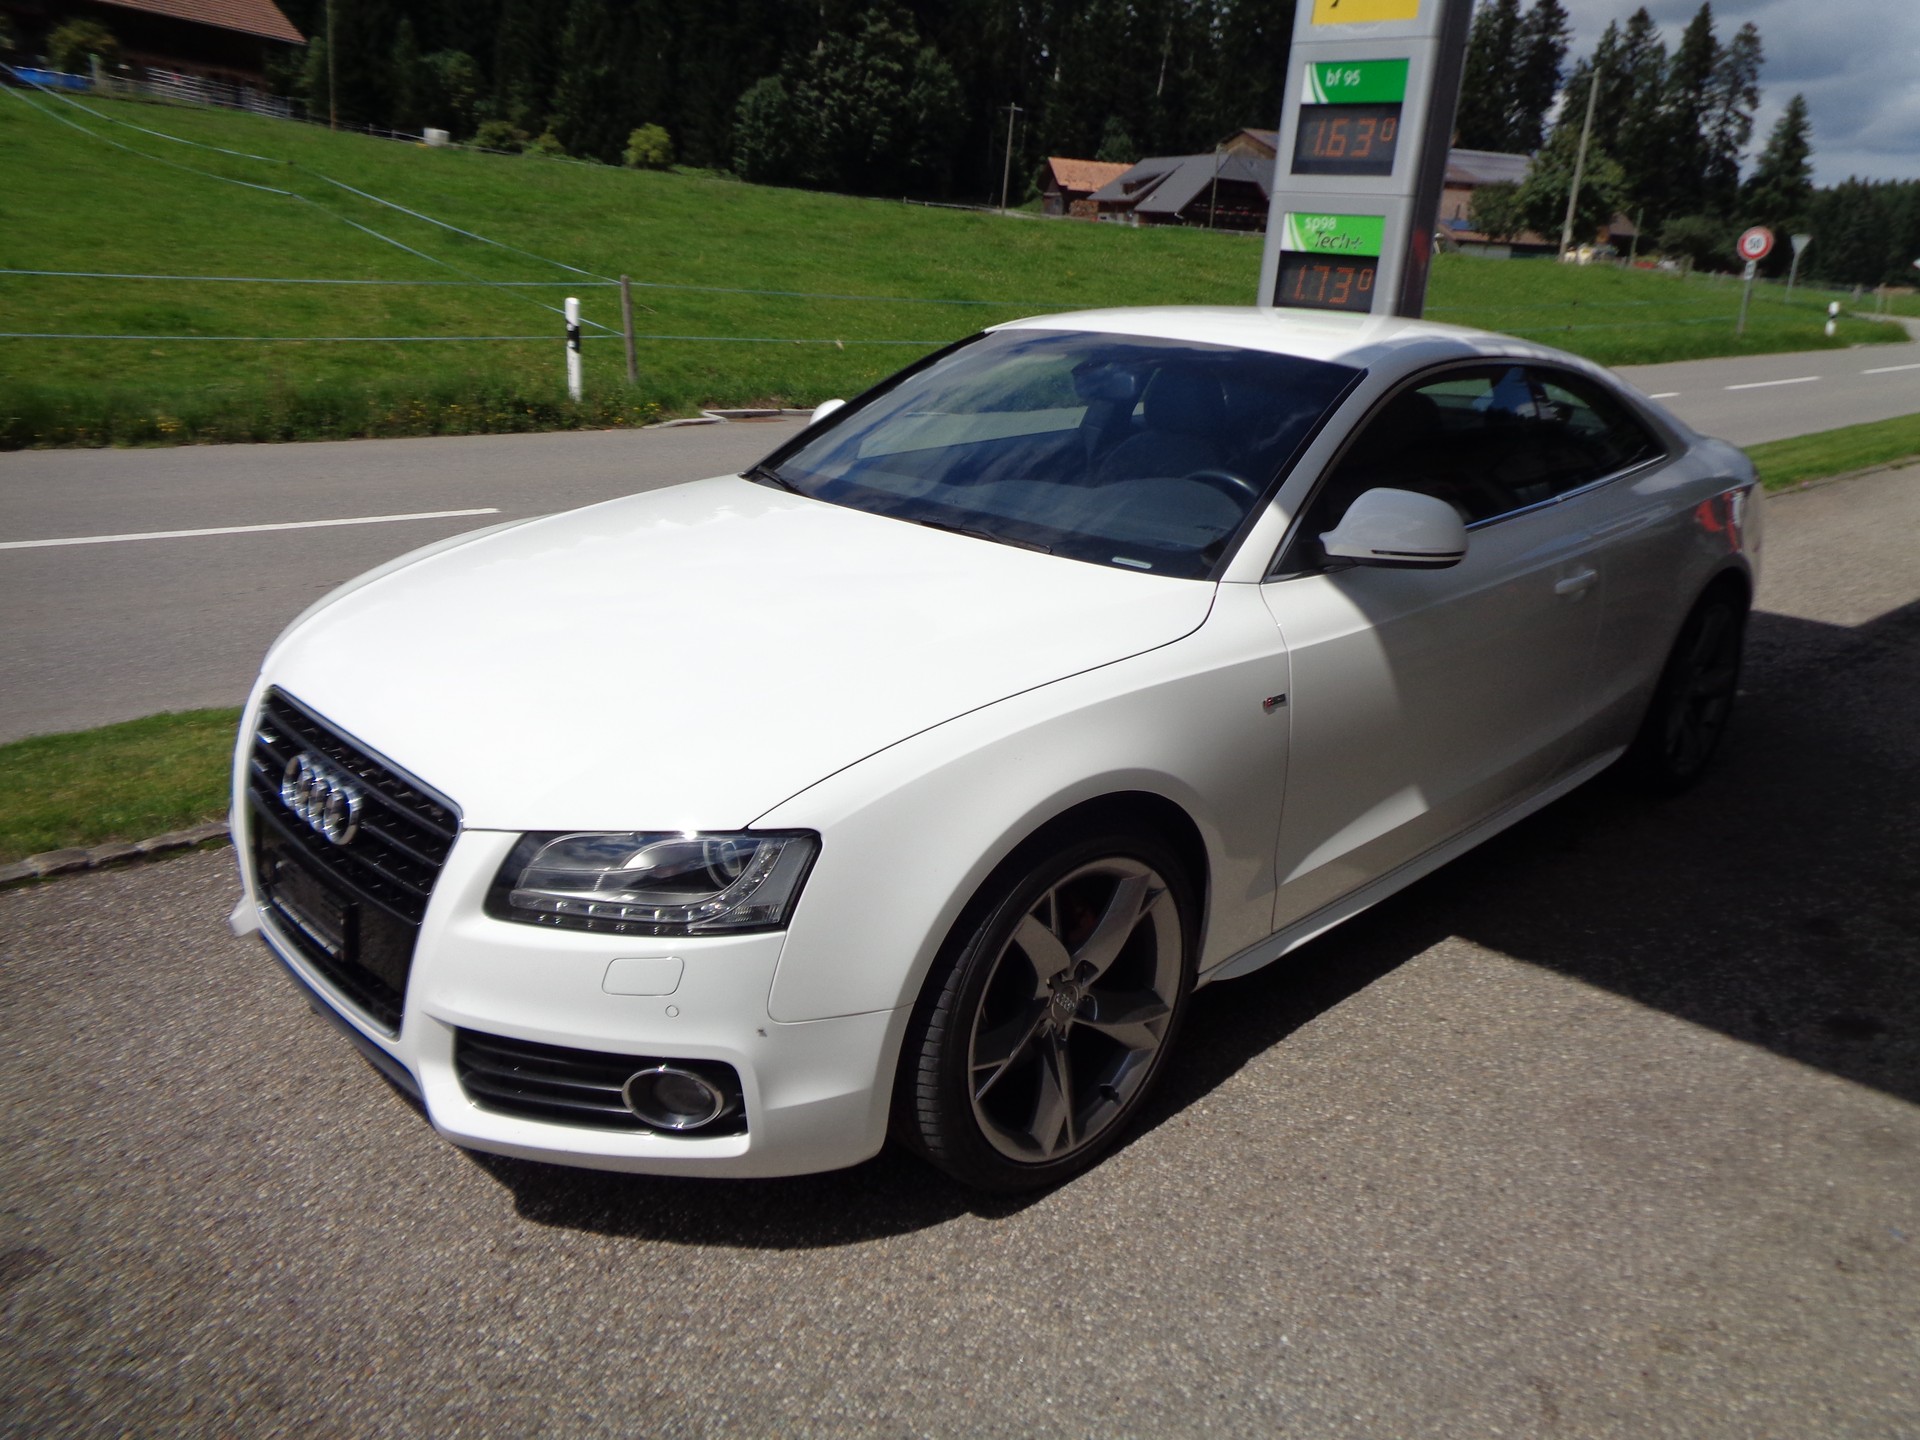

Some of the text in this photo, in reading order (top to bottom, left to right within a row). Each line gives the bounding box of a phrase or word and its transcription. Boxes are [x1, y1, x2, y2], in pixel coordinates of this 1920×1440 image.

[1325, 67, 1361, 87] bf 95
[1304, 216, 1337, 233] sp98
